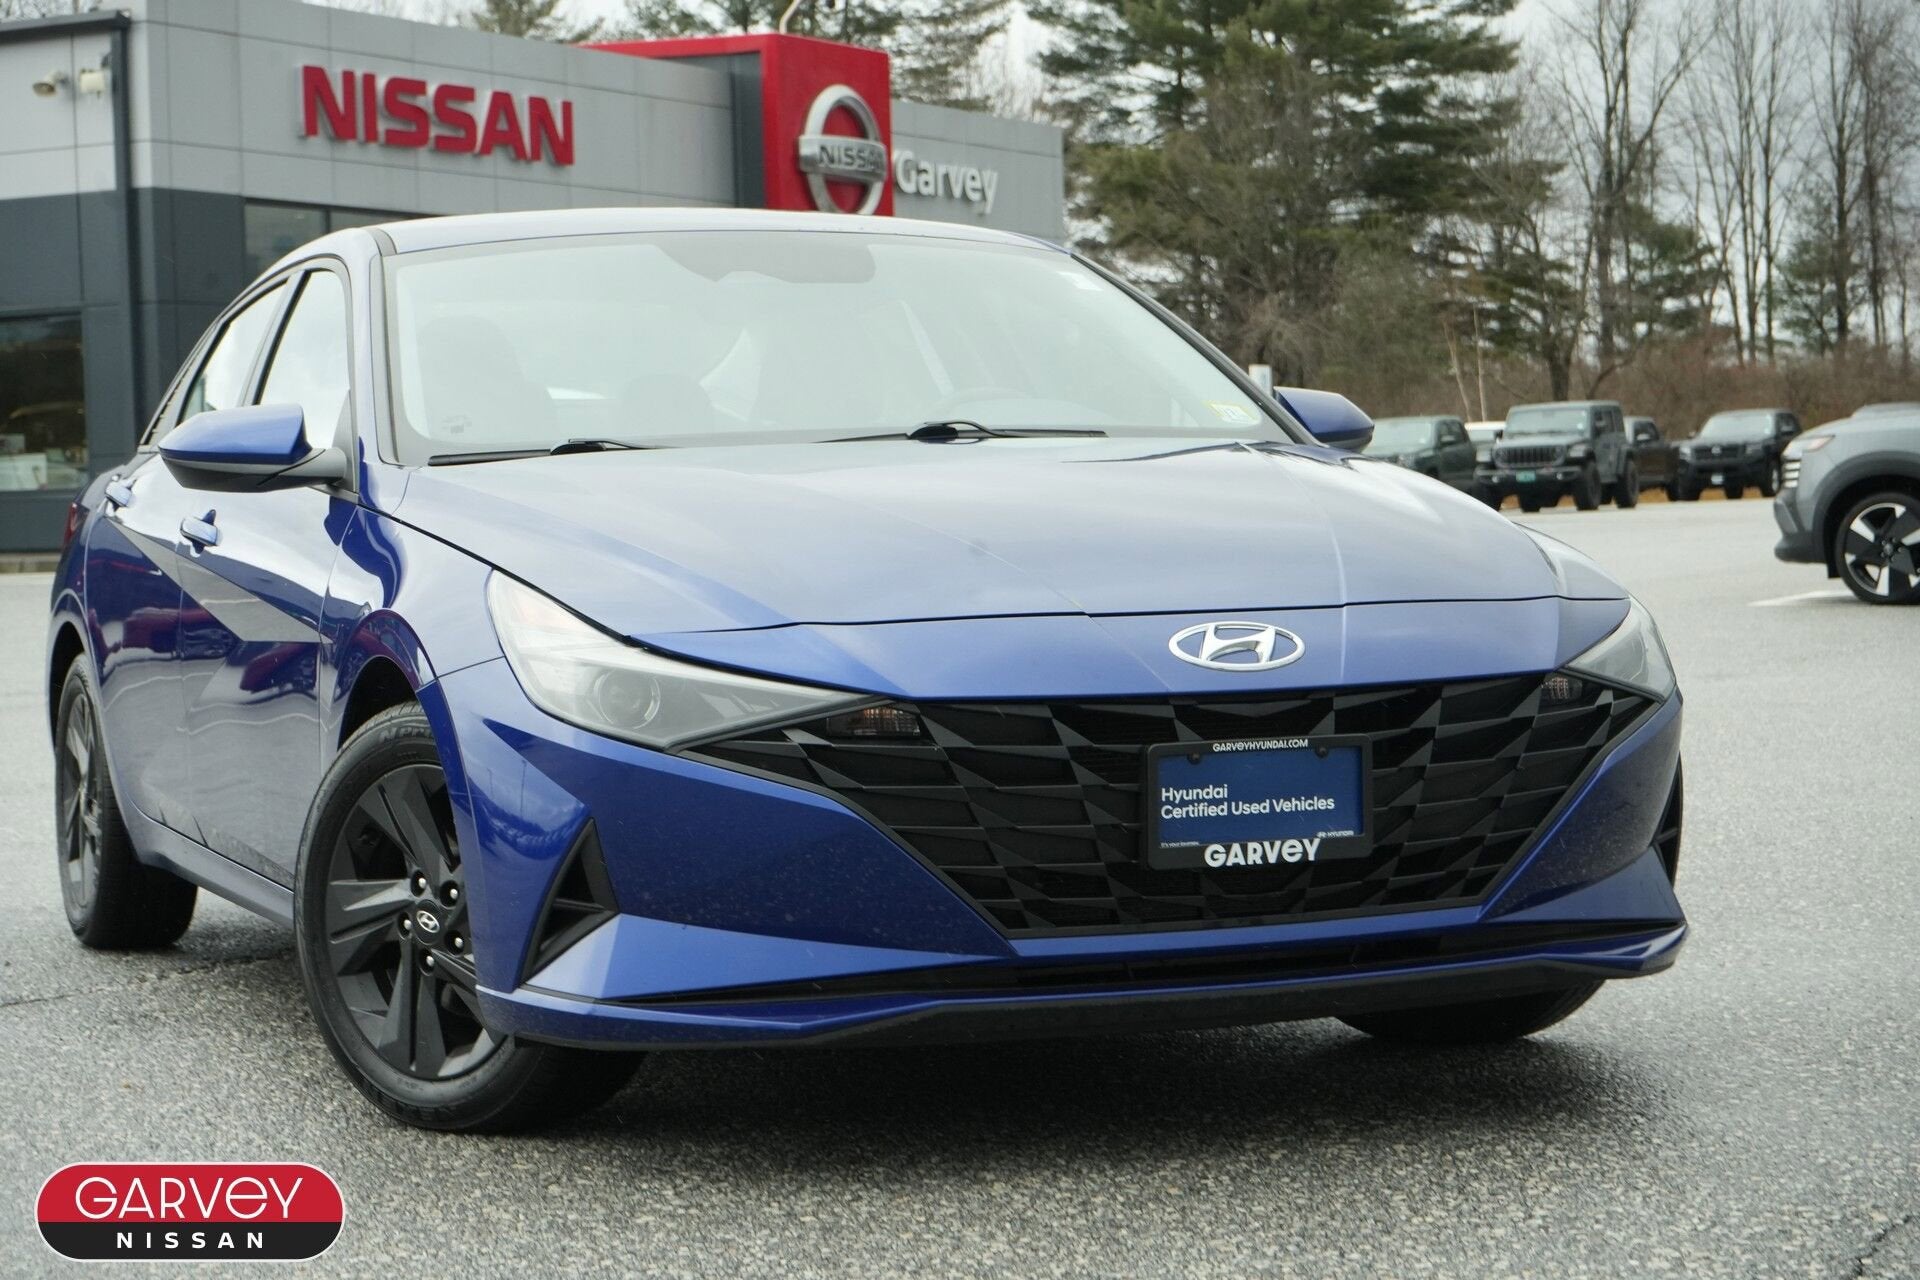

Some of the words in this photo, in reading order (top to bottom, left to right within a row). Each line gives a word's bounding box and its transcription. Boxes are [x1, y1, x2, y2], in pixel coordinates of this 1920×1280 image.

[302, 65, 575, 166] NISSAN
[895, 150, 998, 215] Garvey
[1160, 801, 1228, 819] Certified
[1231, 798, 1270, 815] Used
[1272, 795, 1335, 813] Vehicles
[1161, 784, 1228, 804] Hyundai
